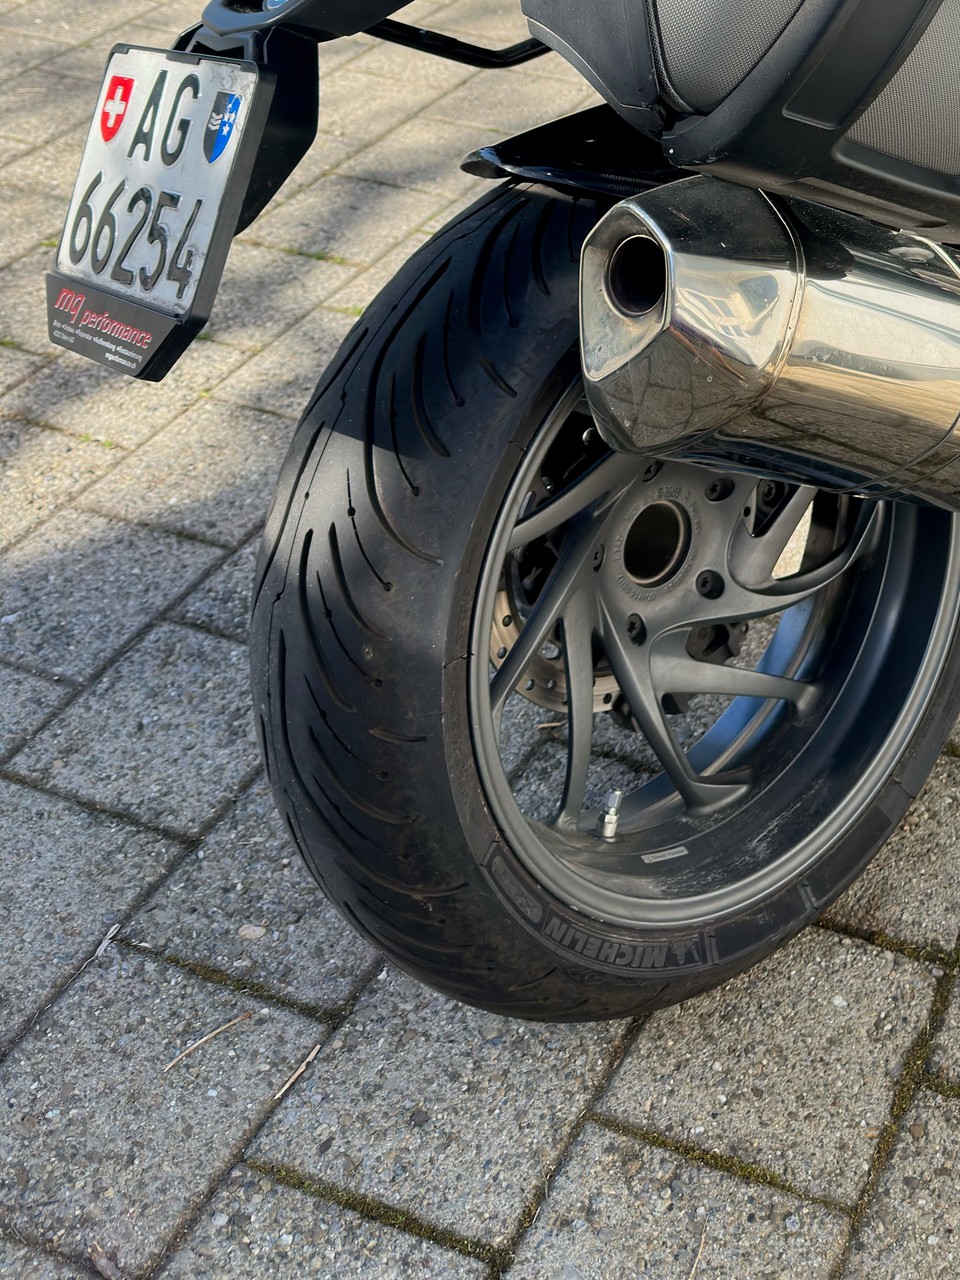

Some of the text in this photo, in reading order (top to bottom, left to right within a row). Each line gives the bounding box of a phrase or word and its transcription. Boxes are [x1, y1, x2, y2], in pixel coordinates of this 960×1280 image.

[126, 69, 200, 167] AG
[69, 170, 203, 299] 66254
[54, 287, 153, 349] mq performance
[544, 916, 669, 968] MICHELIN
